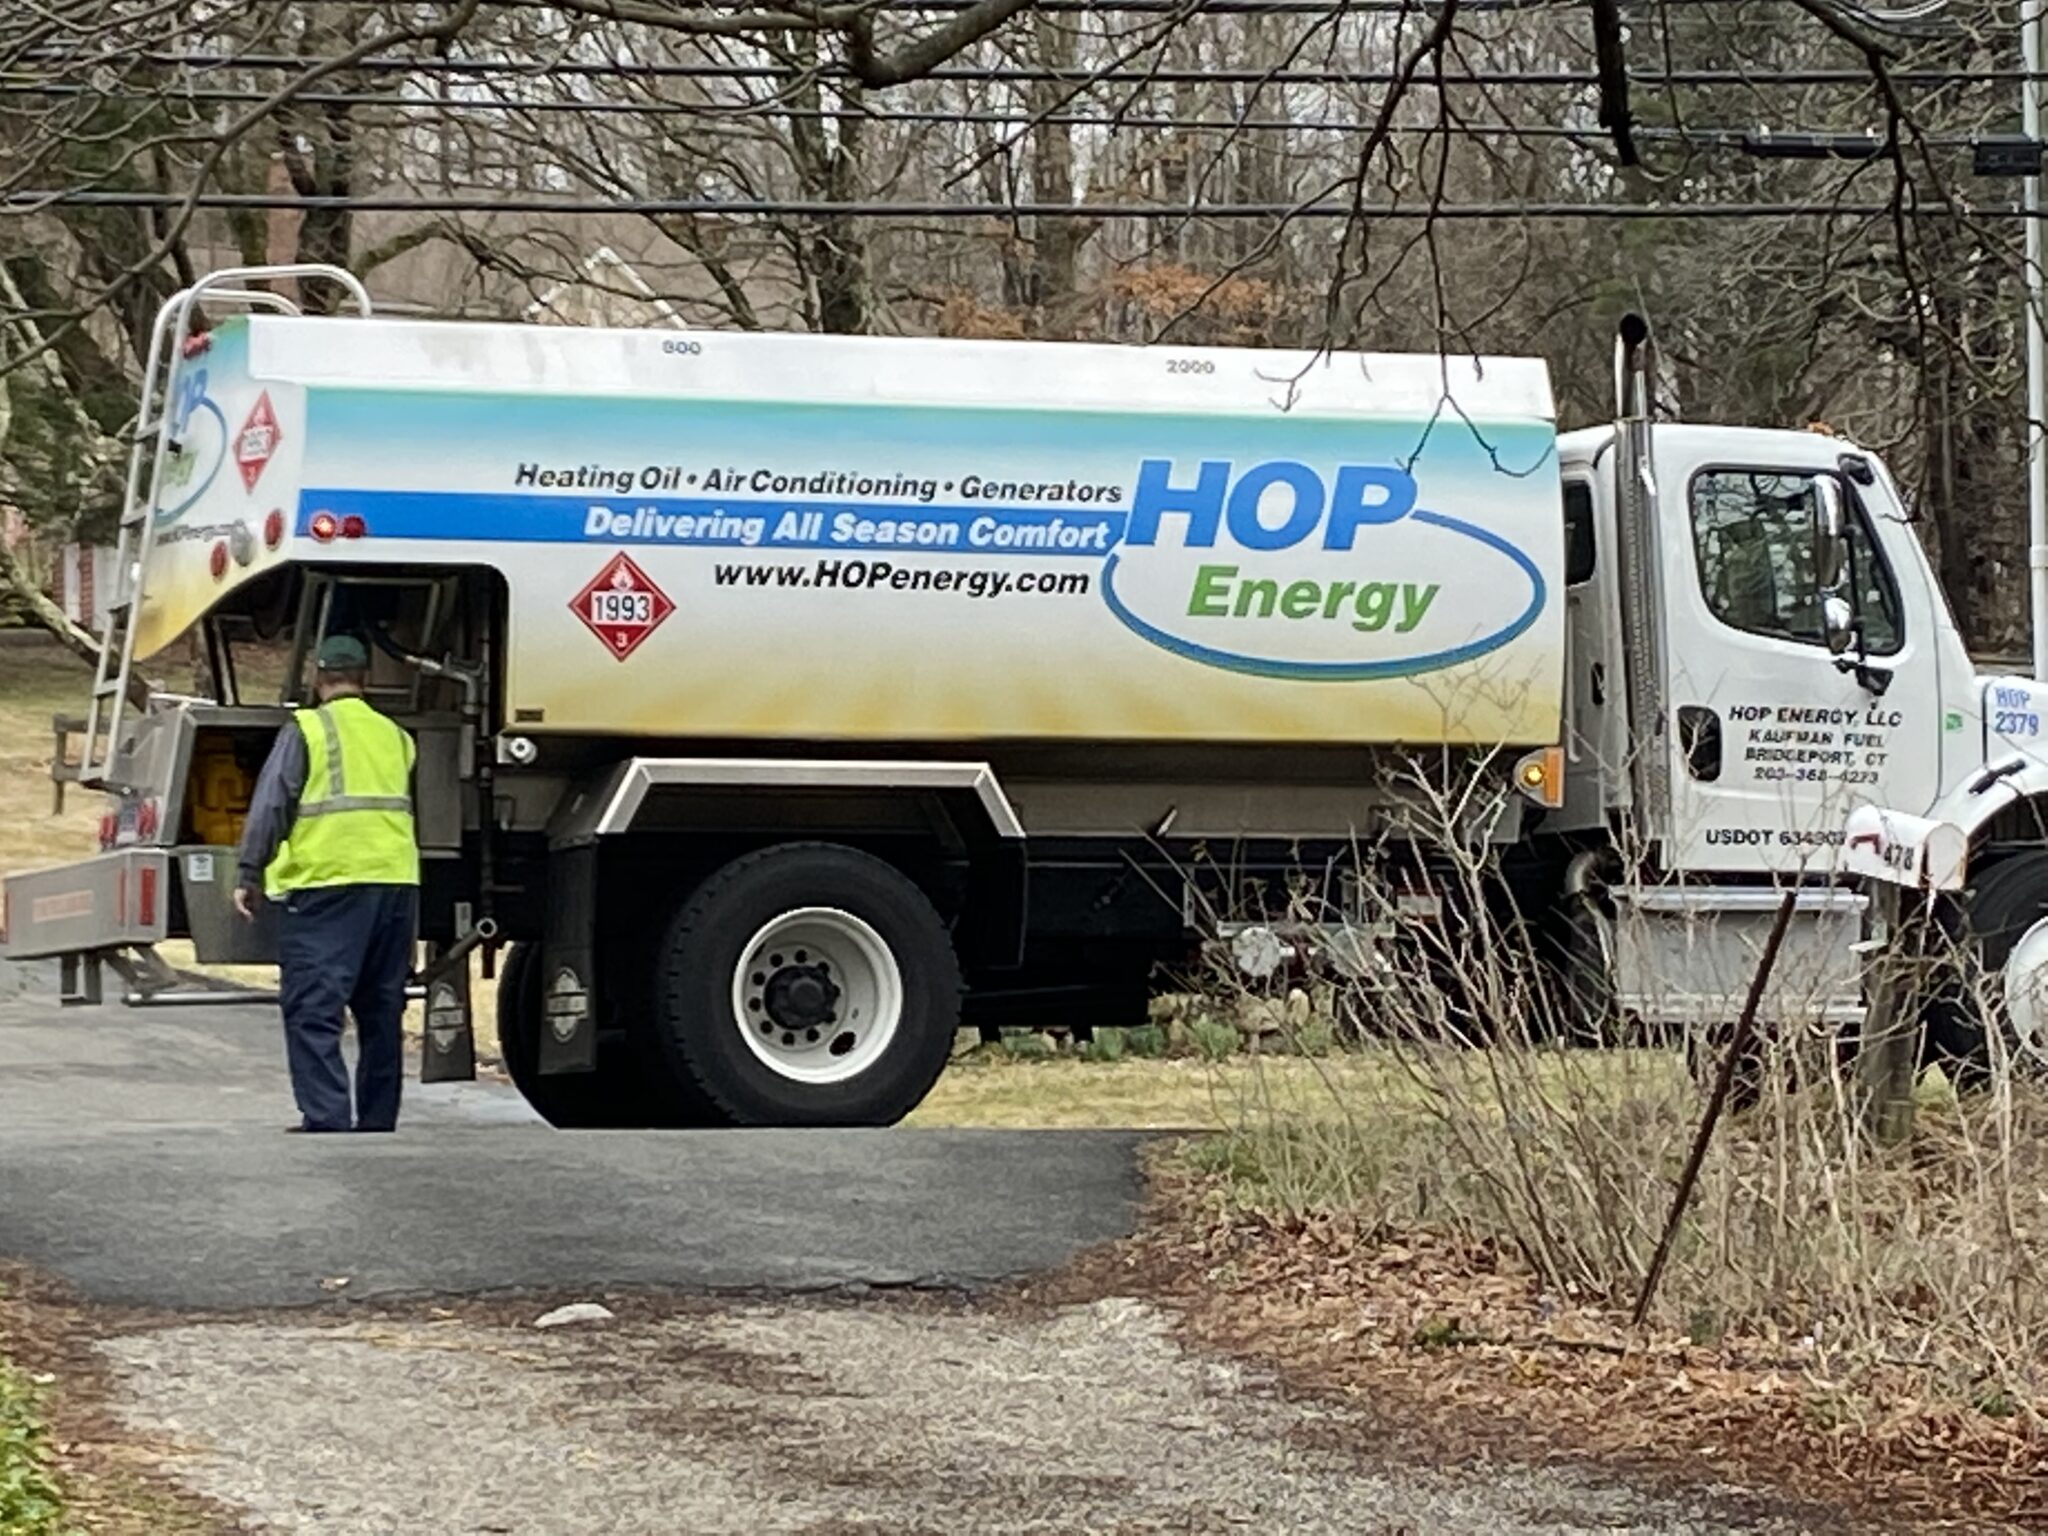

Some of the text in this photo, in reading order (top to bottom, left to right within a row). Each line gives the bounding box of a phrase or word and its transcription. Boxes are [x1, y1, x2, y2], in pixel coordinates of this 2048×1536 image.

[515, 463, 1122, 503] Heating Oil Air Conditioning Generators
[1125, 459, 1418, 551] HOP
[584, 505, 1111, 549] Delivering All Season Comfort
[714, 559, 1090, 598] www.HOPenergy.com
[594, 595, 650, 622] 1993
[1187, 564, 1440, 633] Energy
[615, 631, 628, 648] 3
[1729, 706, 1772, 721] HOP
[1865, 711, 1903, 726] LLC
[1995, 711, 2039, 736] 2379
[1749, 729, 1886, 748] KAUFMAN FUEL
[1865, 753, 1888, 766] CT
[1706, 829, 1774, 846] USDOT
